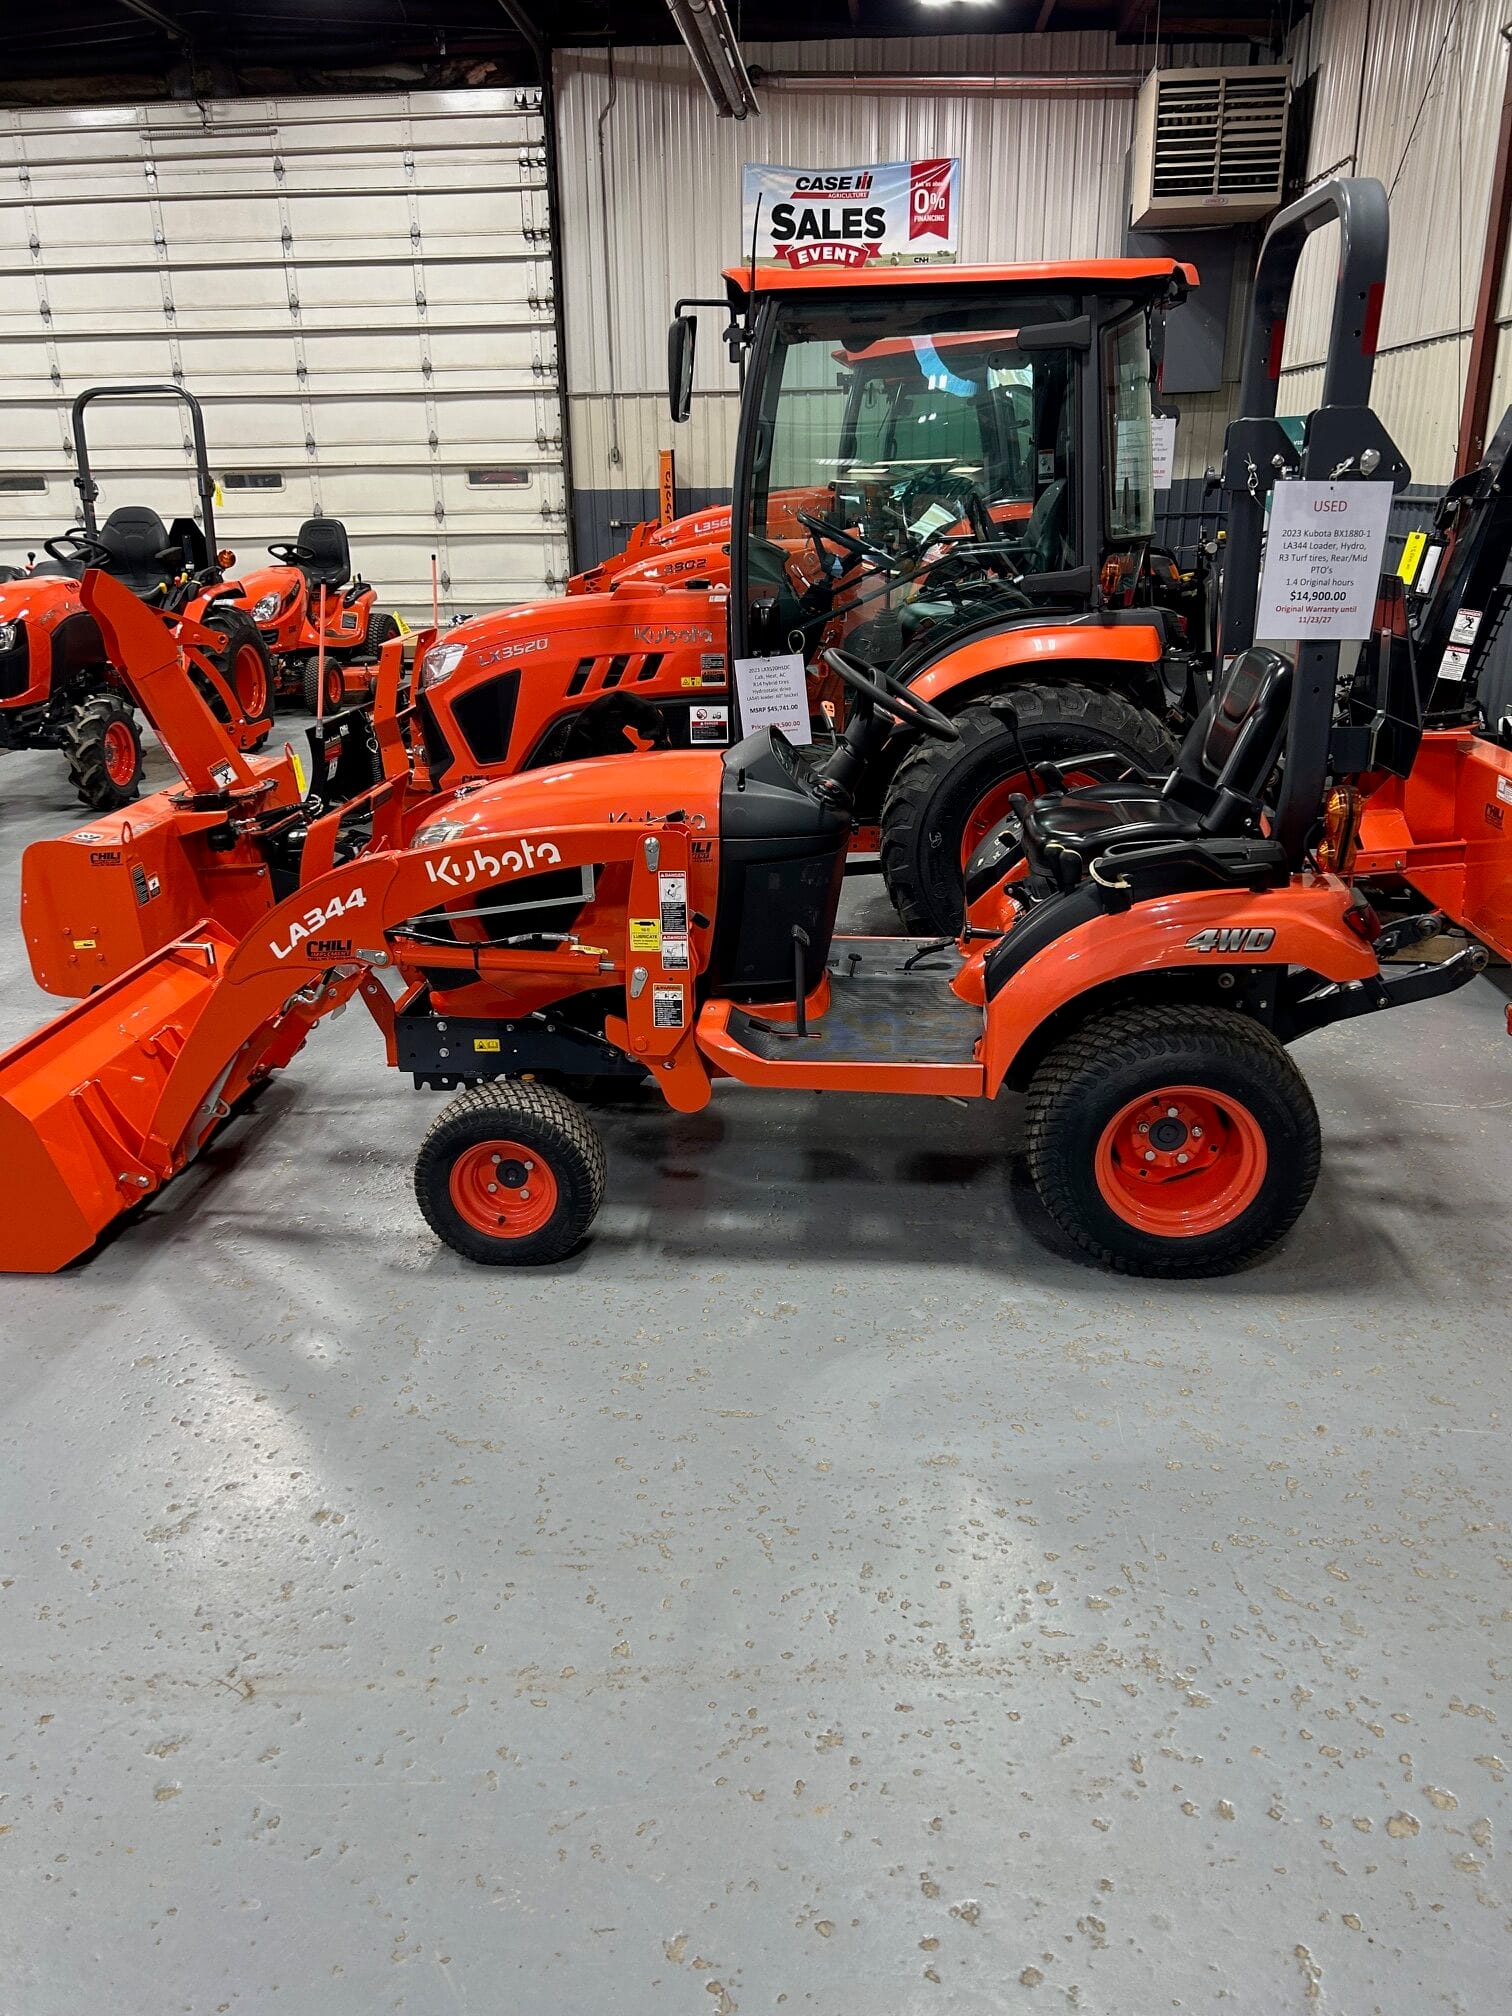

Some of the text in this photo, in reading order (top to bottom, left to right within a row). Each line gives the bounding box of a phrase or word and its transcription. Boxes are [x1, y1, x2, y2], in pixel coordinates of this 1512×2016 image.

[795, 176, 852, 191] CASE
[828, 191, 868, 199] AGRICULTURE
[914, 189, 945, 214] 0%
[770, 203, 886, 241] SALES
[914, 214, 945, 222] FINANCING
[797, 246, 859, 265] EVENT
[1313, 501, 1348, 512] USED
[1281, 529, 1371, 537] 2023 Kubota BX1880-1
[1283, 541, 1367, 551] LA344 Loader, Hydro,
[1309, 554, 1327, 562] tires,
[1330, 554, 1368, 562] Rear/Mid
[1310, 566, 1333, 574] PTO's
[1299, 578, 1330, 587] Original
[1332, 578, 1354, 586] hours
[1289, 591, 1347, 602] $14,900.00
[1275, 605, 1357, 615] Original Warranty until
[1298, 616, 1332, 624] 11/23/27
[633, 625, 713, 644] Kubota
[478, 638, 549, 666] LX3520
[749, 703, 799, 714] MSRP $45,741.00
[90, 851, 121, 864] CHILI
[424, 838, 562, 887] Kubota
[268, 887, 367, 960] LA344
[1185, 927, 1276, 953] 4WD
[305, 939, 352, 958] CHILI
